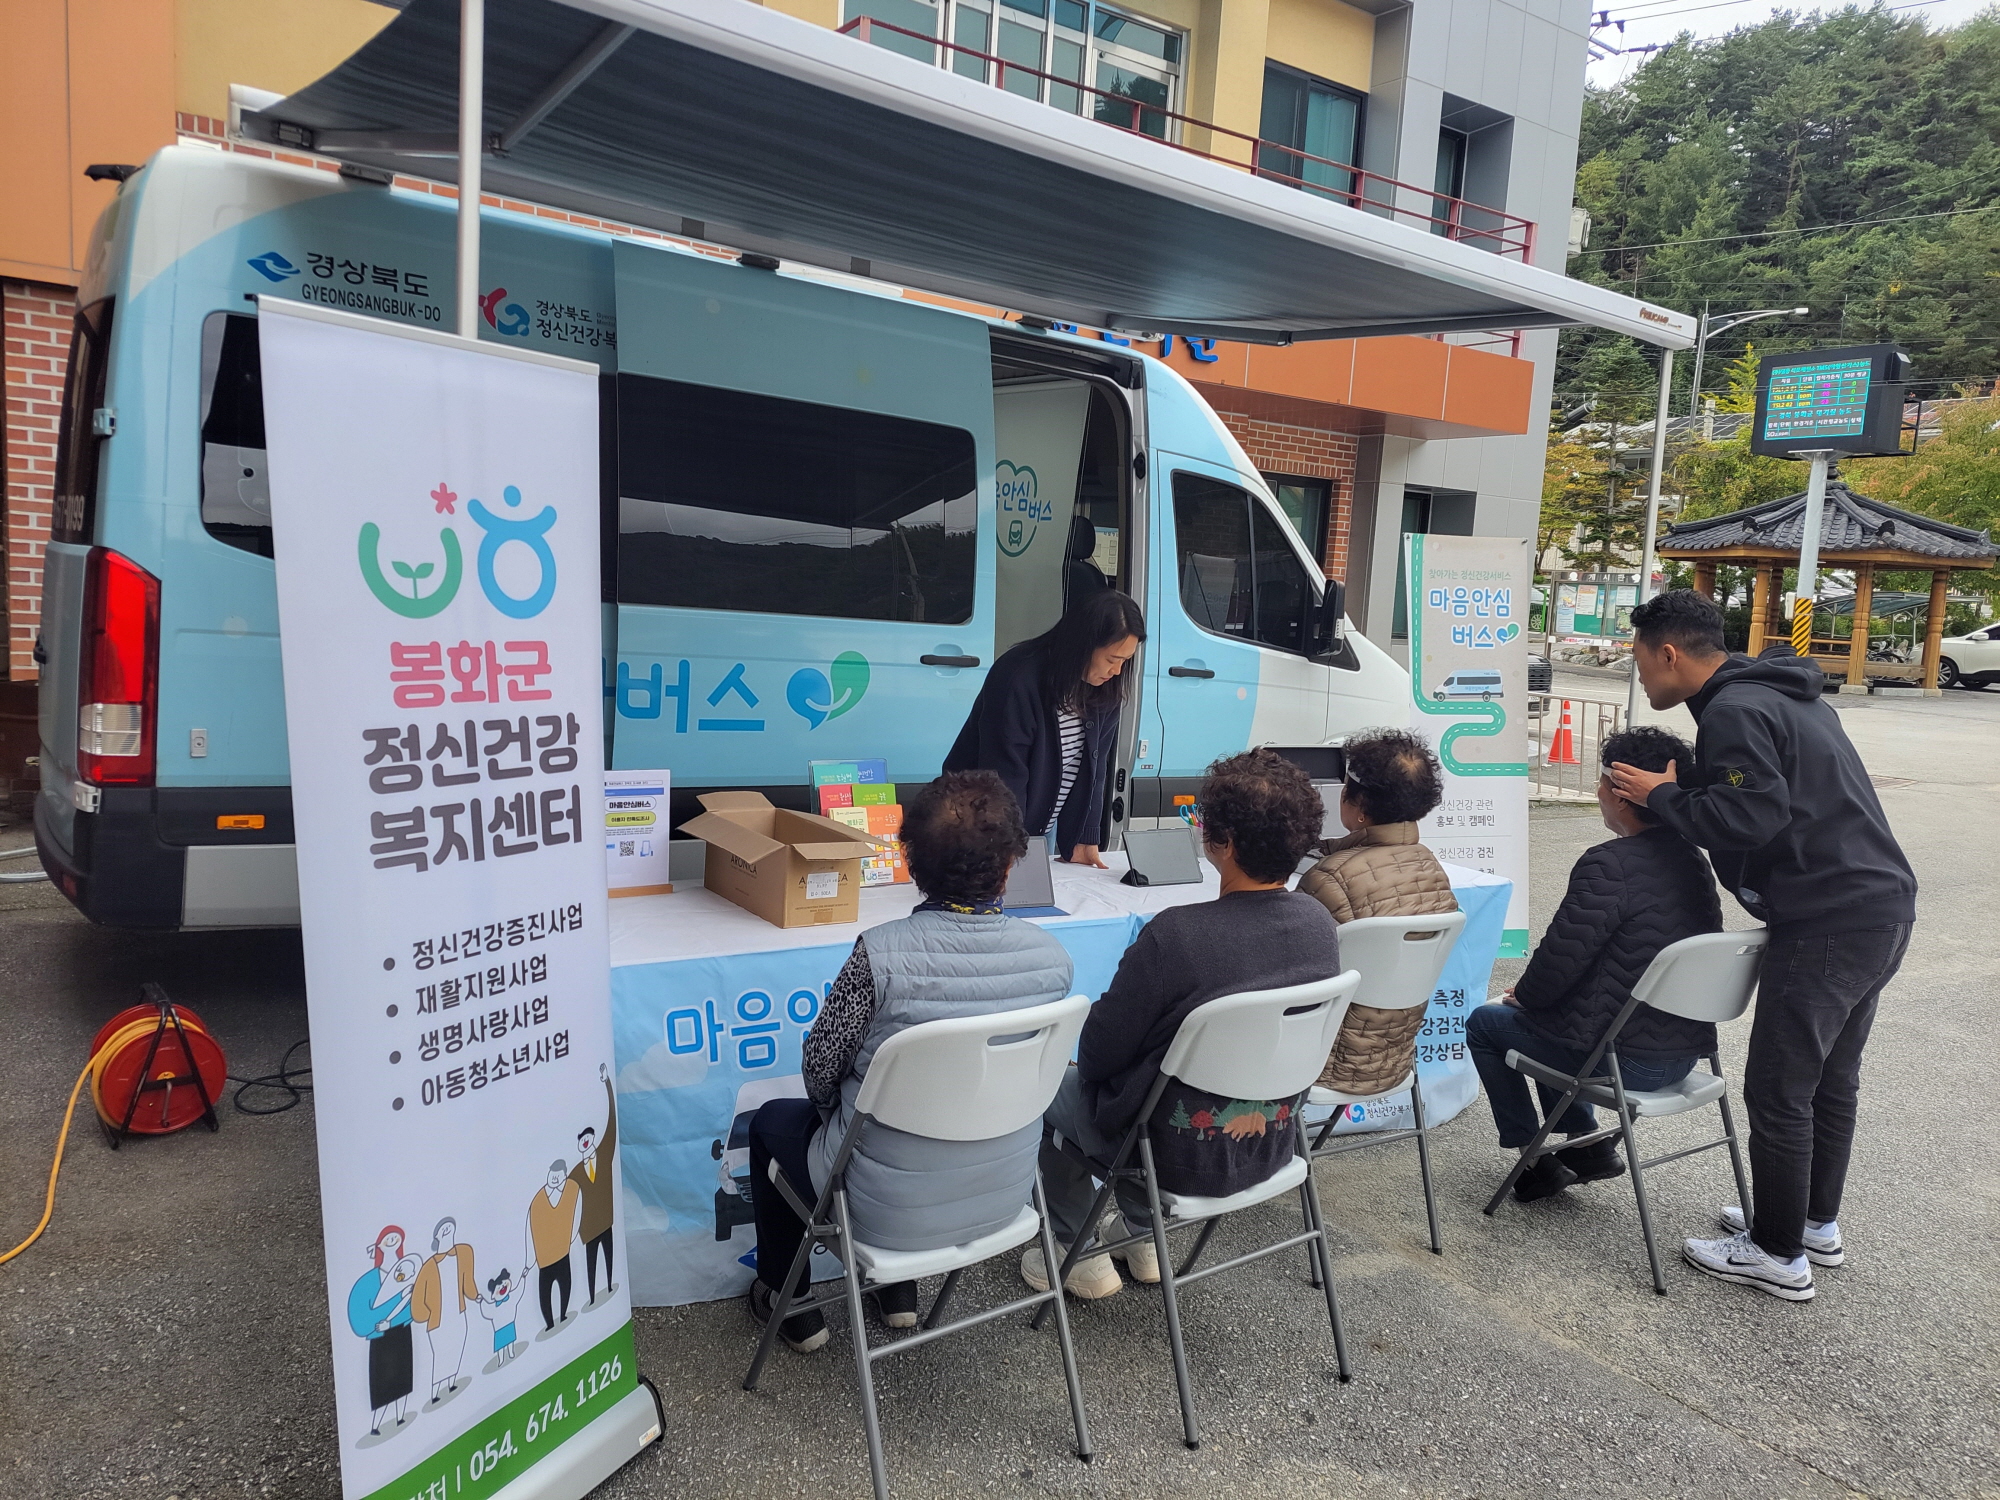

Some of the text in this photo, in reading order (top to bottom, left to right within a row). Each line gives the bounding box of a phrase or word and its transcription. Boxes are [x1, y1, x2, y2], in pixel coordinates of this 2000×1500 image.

[306, 252, 430, 298] 경상북도
[301, 283, 441, 322] GYEONGSANGBUK-DO
[536, 299, 593, 323] 경상북도
[536, 318, 618, 350] 정신건강복
[1428, 568, 1512, 581] 찾아가는 정신건강서비스
[1429, 587, 1512, 618] 마음안심
[1451, 625, 1495, 649] 버스
[389, 640, 552, 709] 봉화군
[616, 658, 766, 734] 버스
[362, 712, 581, 795] 정신건강
[608, 800, 652, 809] 마음안심버스
[1436, 814, 1495, 828] 홍보 및 캠페인
[1438, 799, 1494, 812] 정신건강 관련
[369, 784, 583, 874] 복지센터
[1438, 846, 1494, 860] 정신건강 검진
[412, 902, 583, 971] 정신건강증진사업
[415, 953, 548, 1016] 재활지원사업
[1432, 988, 1465, 1008] 측정
[417, 994, 549, 1063] 생명사랑사업
[1415, 1015, 1465, 1037] 강검진
[420, 1029, 570, 1107] 아동청소년사업
[575, 1353, 623, 1409] 1126
